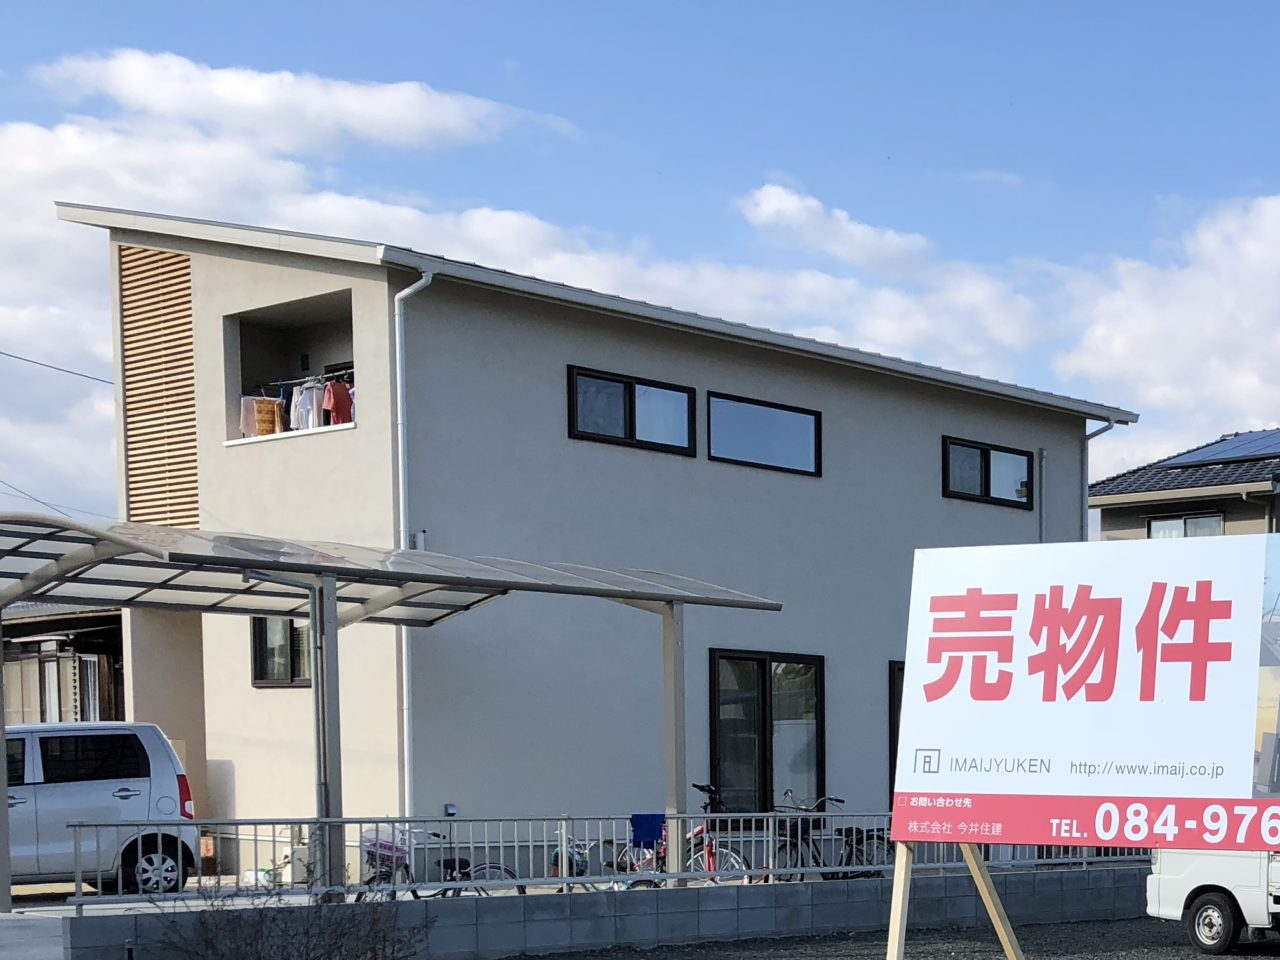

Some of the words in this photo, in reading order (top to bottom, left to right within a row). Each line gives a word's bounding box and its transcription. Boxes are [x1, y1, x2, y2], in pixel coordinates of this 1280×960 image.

[923, 579, 1233, 703] 売物件
[949, 757, 1052, 774] IMAIJYUKEN
[1070, 761, 1225, 780] http://www.imaij.co.jp
[909, 796, 973, 808] お問い合わせ先
[907, 819, 953, 835] 株式会社
[957, 820, 1003, 836] 今井住建
[1050, 818, 1088, 838] TEL.
